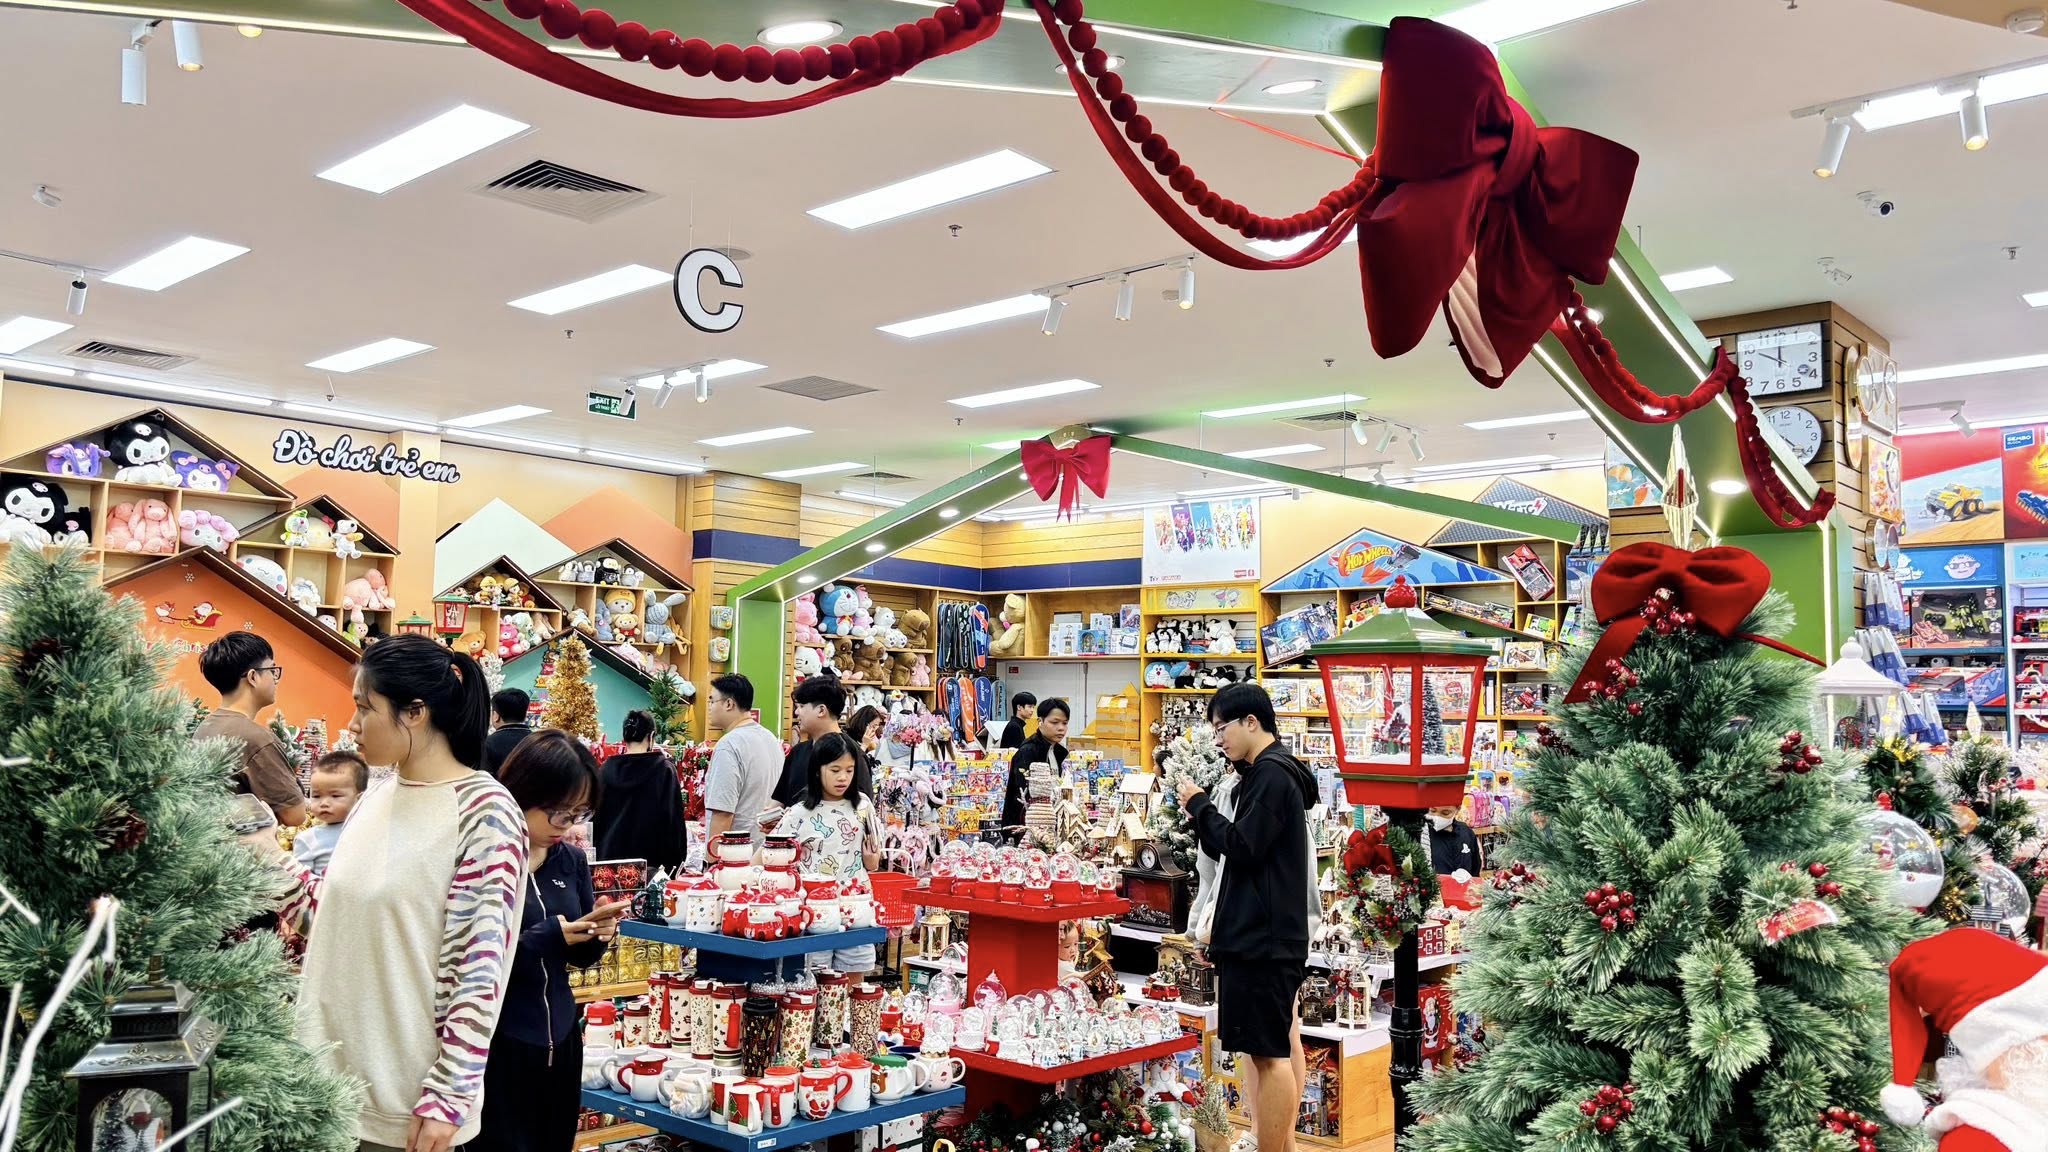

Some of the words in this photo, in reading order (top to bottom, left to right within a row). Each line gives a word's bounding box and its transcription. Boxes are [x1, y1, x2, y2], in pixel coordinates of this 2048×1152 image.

[674, 248, 743, 333] C
[1808, 352, 1818, 362] 3
[1744, 360, 1753, 370] 9
[1808, 369, 1818, 379] 4
[1760, 381, 1770, 392] 7
[1776, 379, 1785, 390] 6
[1792, 377, 1801, 388] 5
[1767, 415, 1775, 424] 11
[1780, 410, 1790, 419] 12
[1805, 420, 1812, 429] 2
[1810, 432, 1818, 441] 3
[1806, 445, 1814, 454] 4
[275, 430, 317, 465] Đồ
[321, 435, 376, 471] chơi
[378, 443, 421, 477] trẻ
[421, 461, 460, 483] em
[1345, 552, 1363, 571] HOT
[1362, 545, 1393, 563] WHEELS
